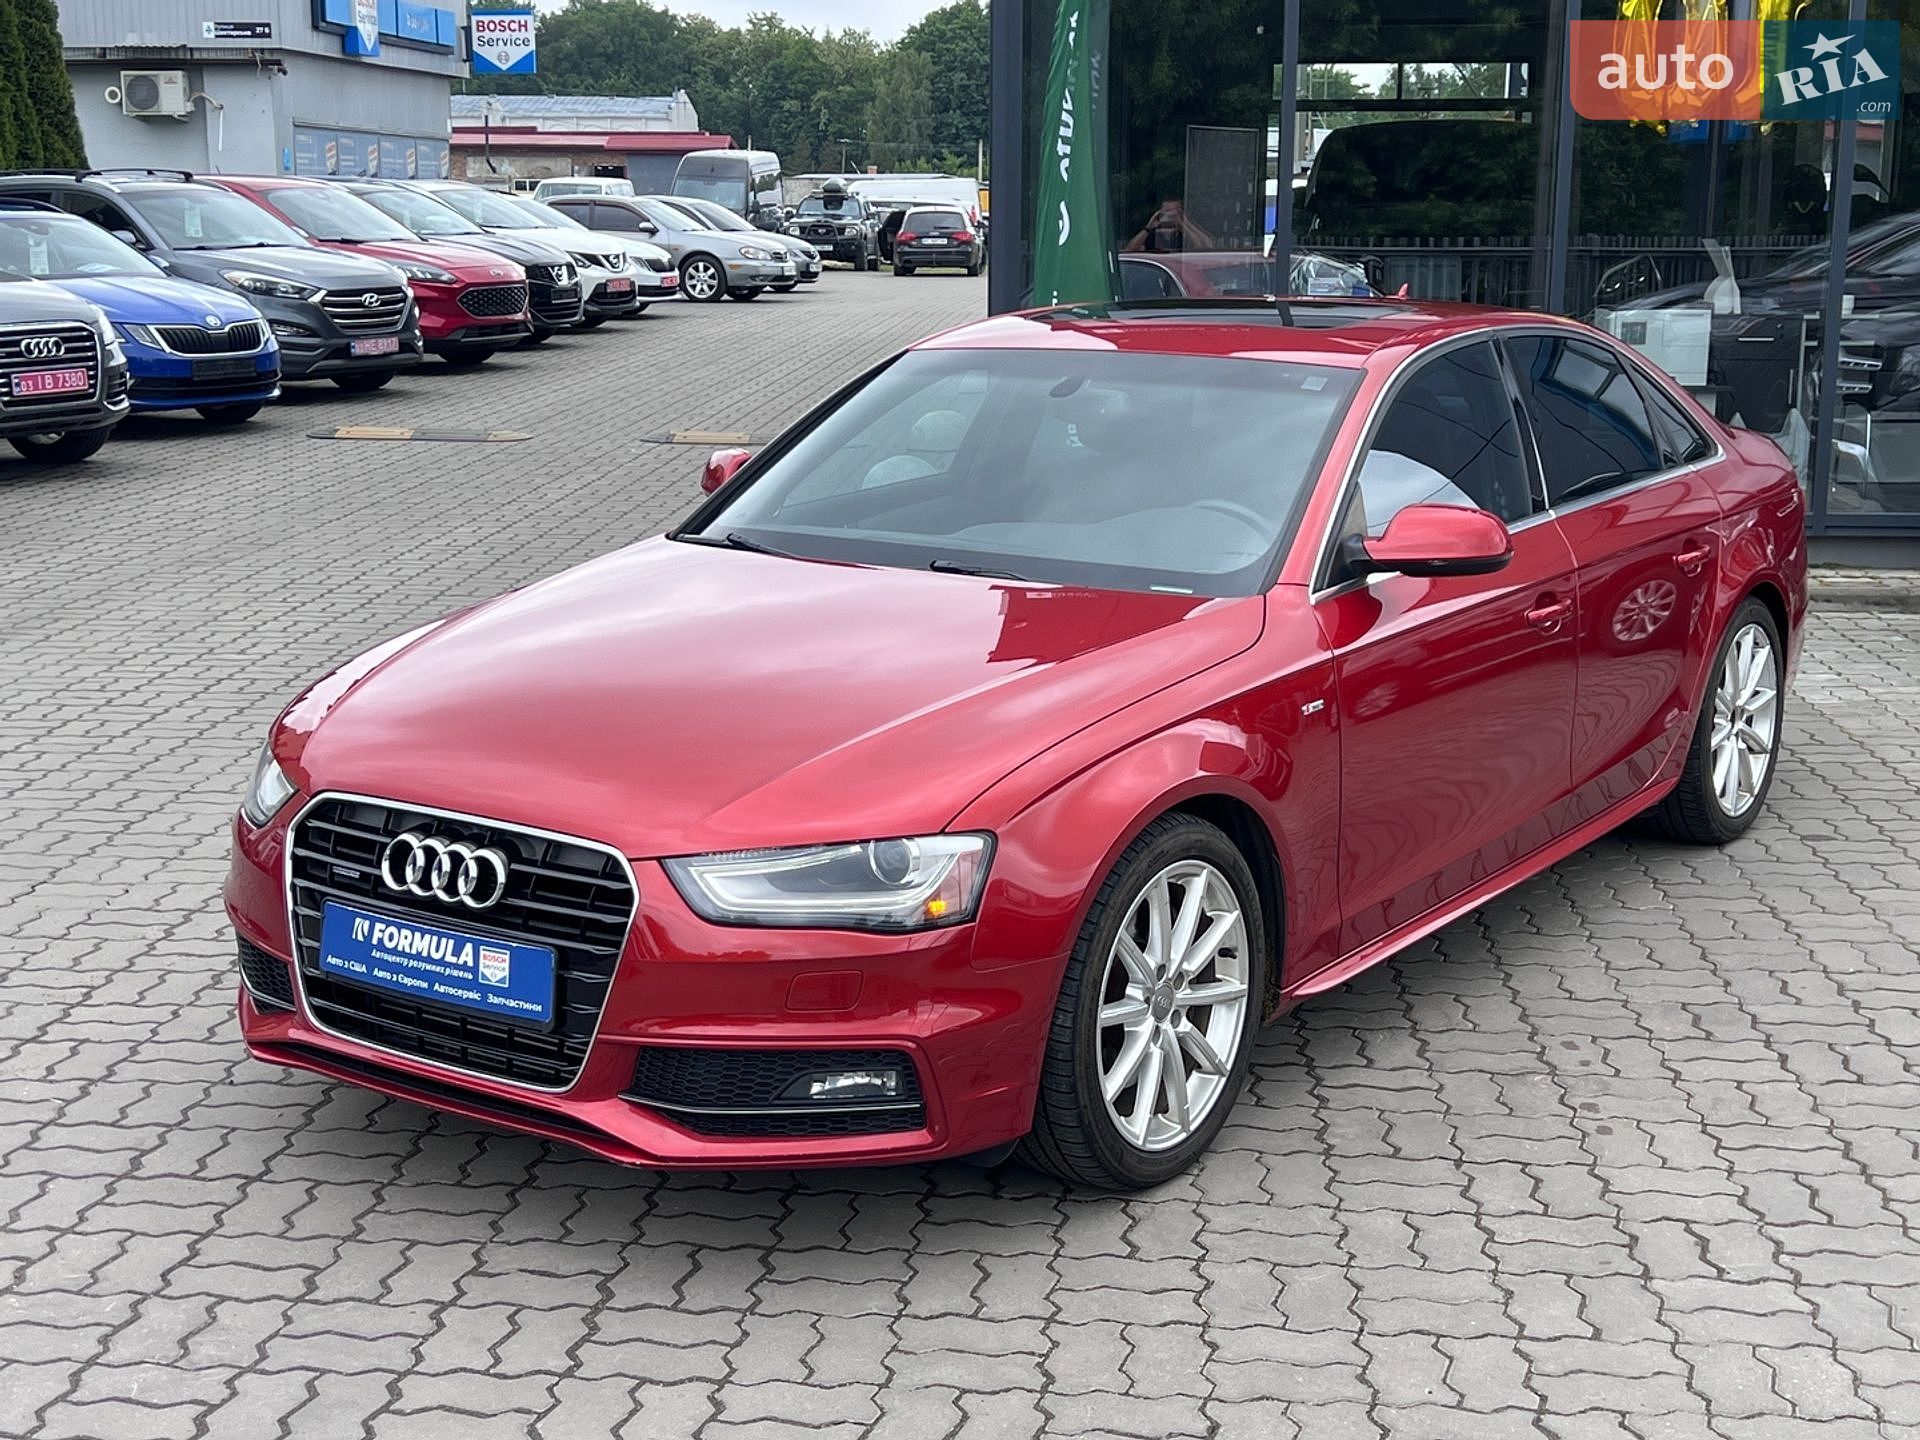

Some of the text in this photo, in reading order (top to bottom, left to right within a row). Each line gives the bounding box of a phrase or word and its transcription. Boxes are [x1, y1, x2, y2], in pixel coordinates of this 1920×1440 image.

[476, 20, 528, 32] BOSCH
[477, 34, 531, 47] Service
[22, 381, 34, 391] 03
[57, 372, 84, 388] 7380
[372, 924, 475, 967] FORMULA
[371, 948, 473, 980] Автоцентр розумних рішень
[482, 953, 507, 964] BOSCH
[482, 962, 506, 972] Service
[326, 954, 344, 967] Авто
[349, 961, 367, 973] США
[373, 967, 391, 980] Авто
[398, 974, 428, 989] Європи
[433, 982, 482, 1001] Автосервіс
[486, 993, 543, 1012] Запчастини
